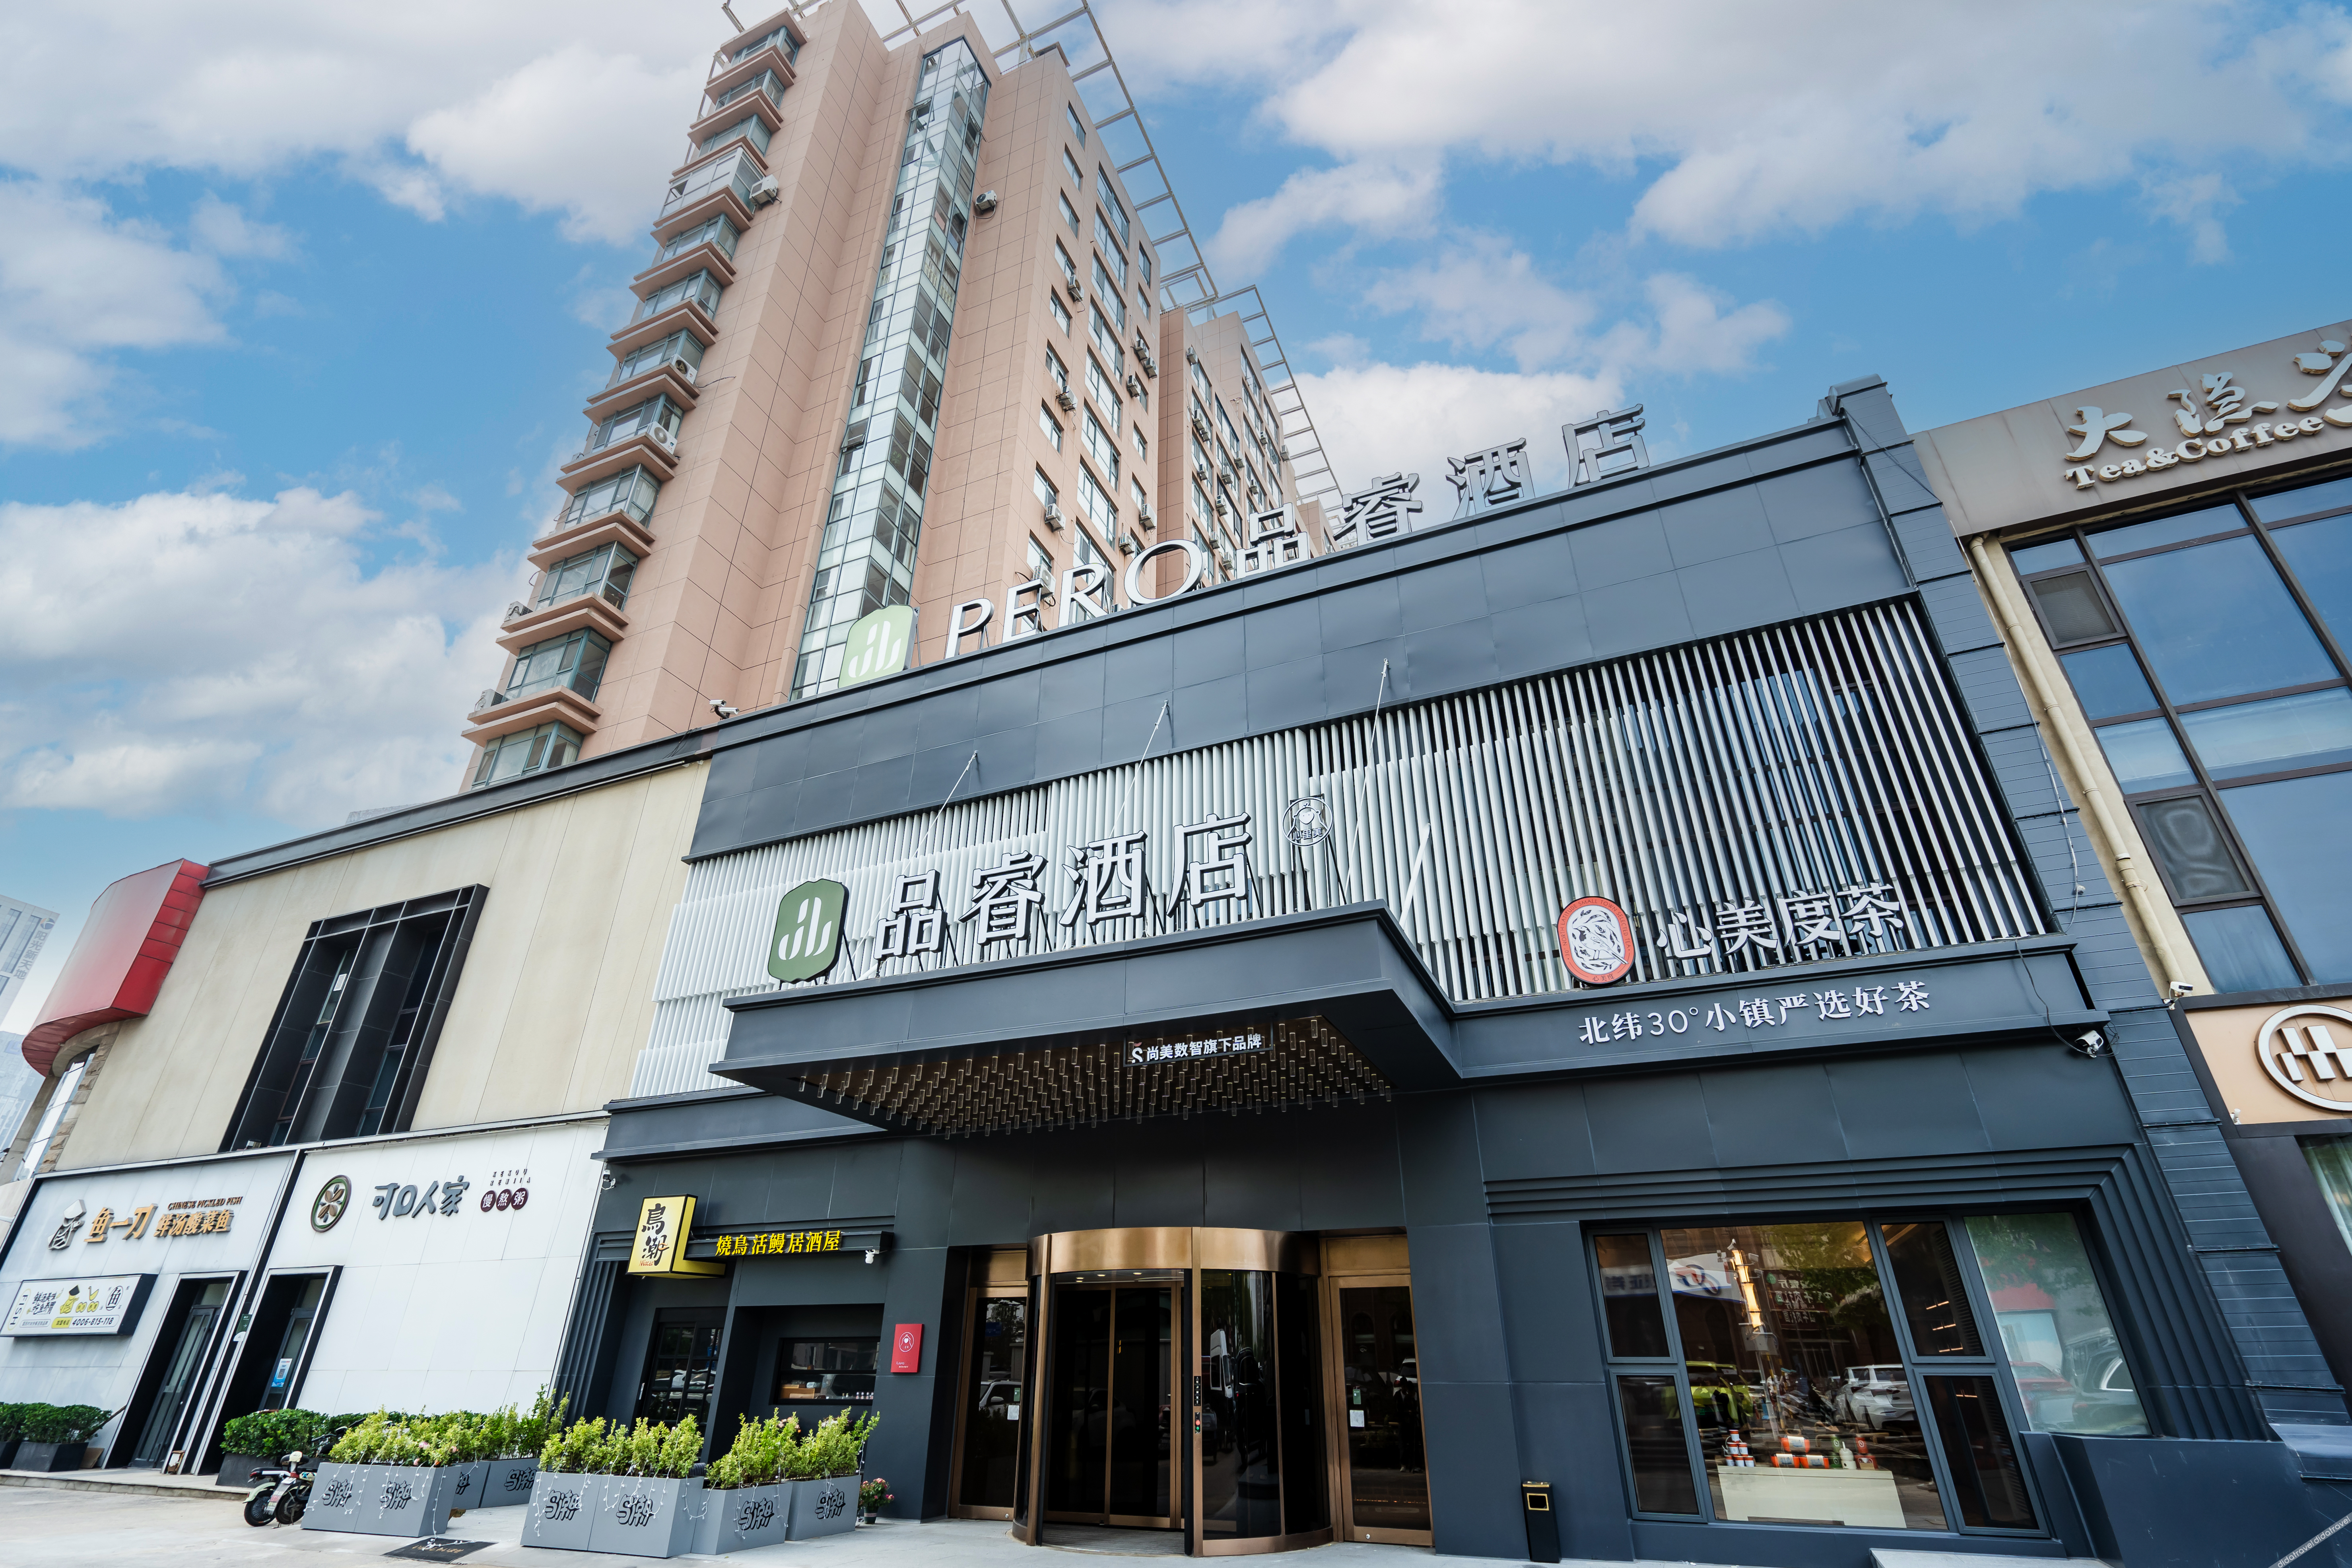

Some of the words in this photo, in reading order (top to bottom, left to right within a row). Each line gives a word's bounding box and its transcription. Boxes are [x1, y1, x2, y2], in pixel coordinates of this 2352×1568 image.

[2065, 416, 2325, 490] Tea&Coffee
[1235, 404, 1651, 579] 品睿酒店
[945, 538, 1206, 659] PERO
[1292, 827, 1323, 840] 心里美
[874, 812, 1252, 960] 品睿酒店
[1600, 900, 1617, 911] TOWN
[1655, 882, 1904, 960] 心美度茶
[13, 930, 48, 979] 阳光新天地
[1592, 973, 1615, 982] 心美度
[1579, 981, 1931, 1045] 北纬30°小镇严选好茶
[1147, 1033, 1262, 1061] 尚美数智旗下品牌
[167, 1202, 196, 1210] CHINESE
[197, 1198, 226, 1208] PICKLED
[227, 1196, 244, 1205] FISH
[482, 1191, 526, 1208] 慢熬粥
[84, 1203, 158, 1242] 鱼一刀
[153, 1209, 235, 1238] 鲜汤酸菜鱼
[10, 1294, 28, 1325] FISH
[72, 1317, 114, 1326] 4006-815-118
